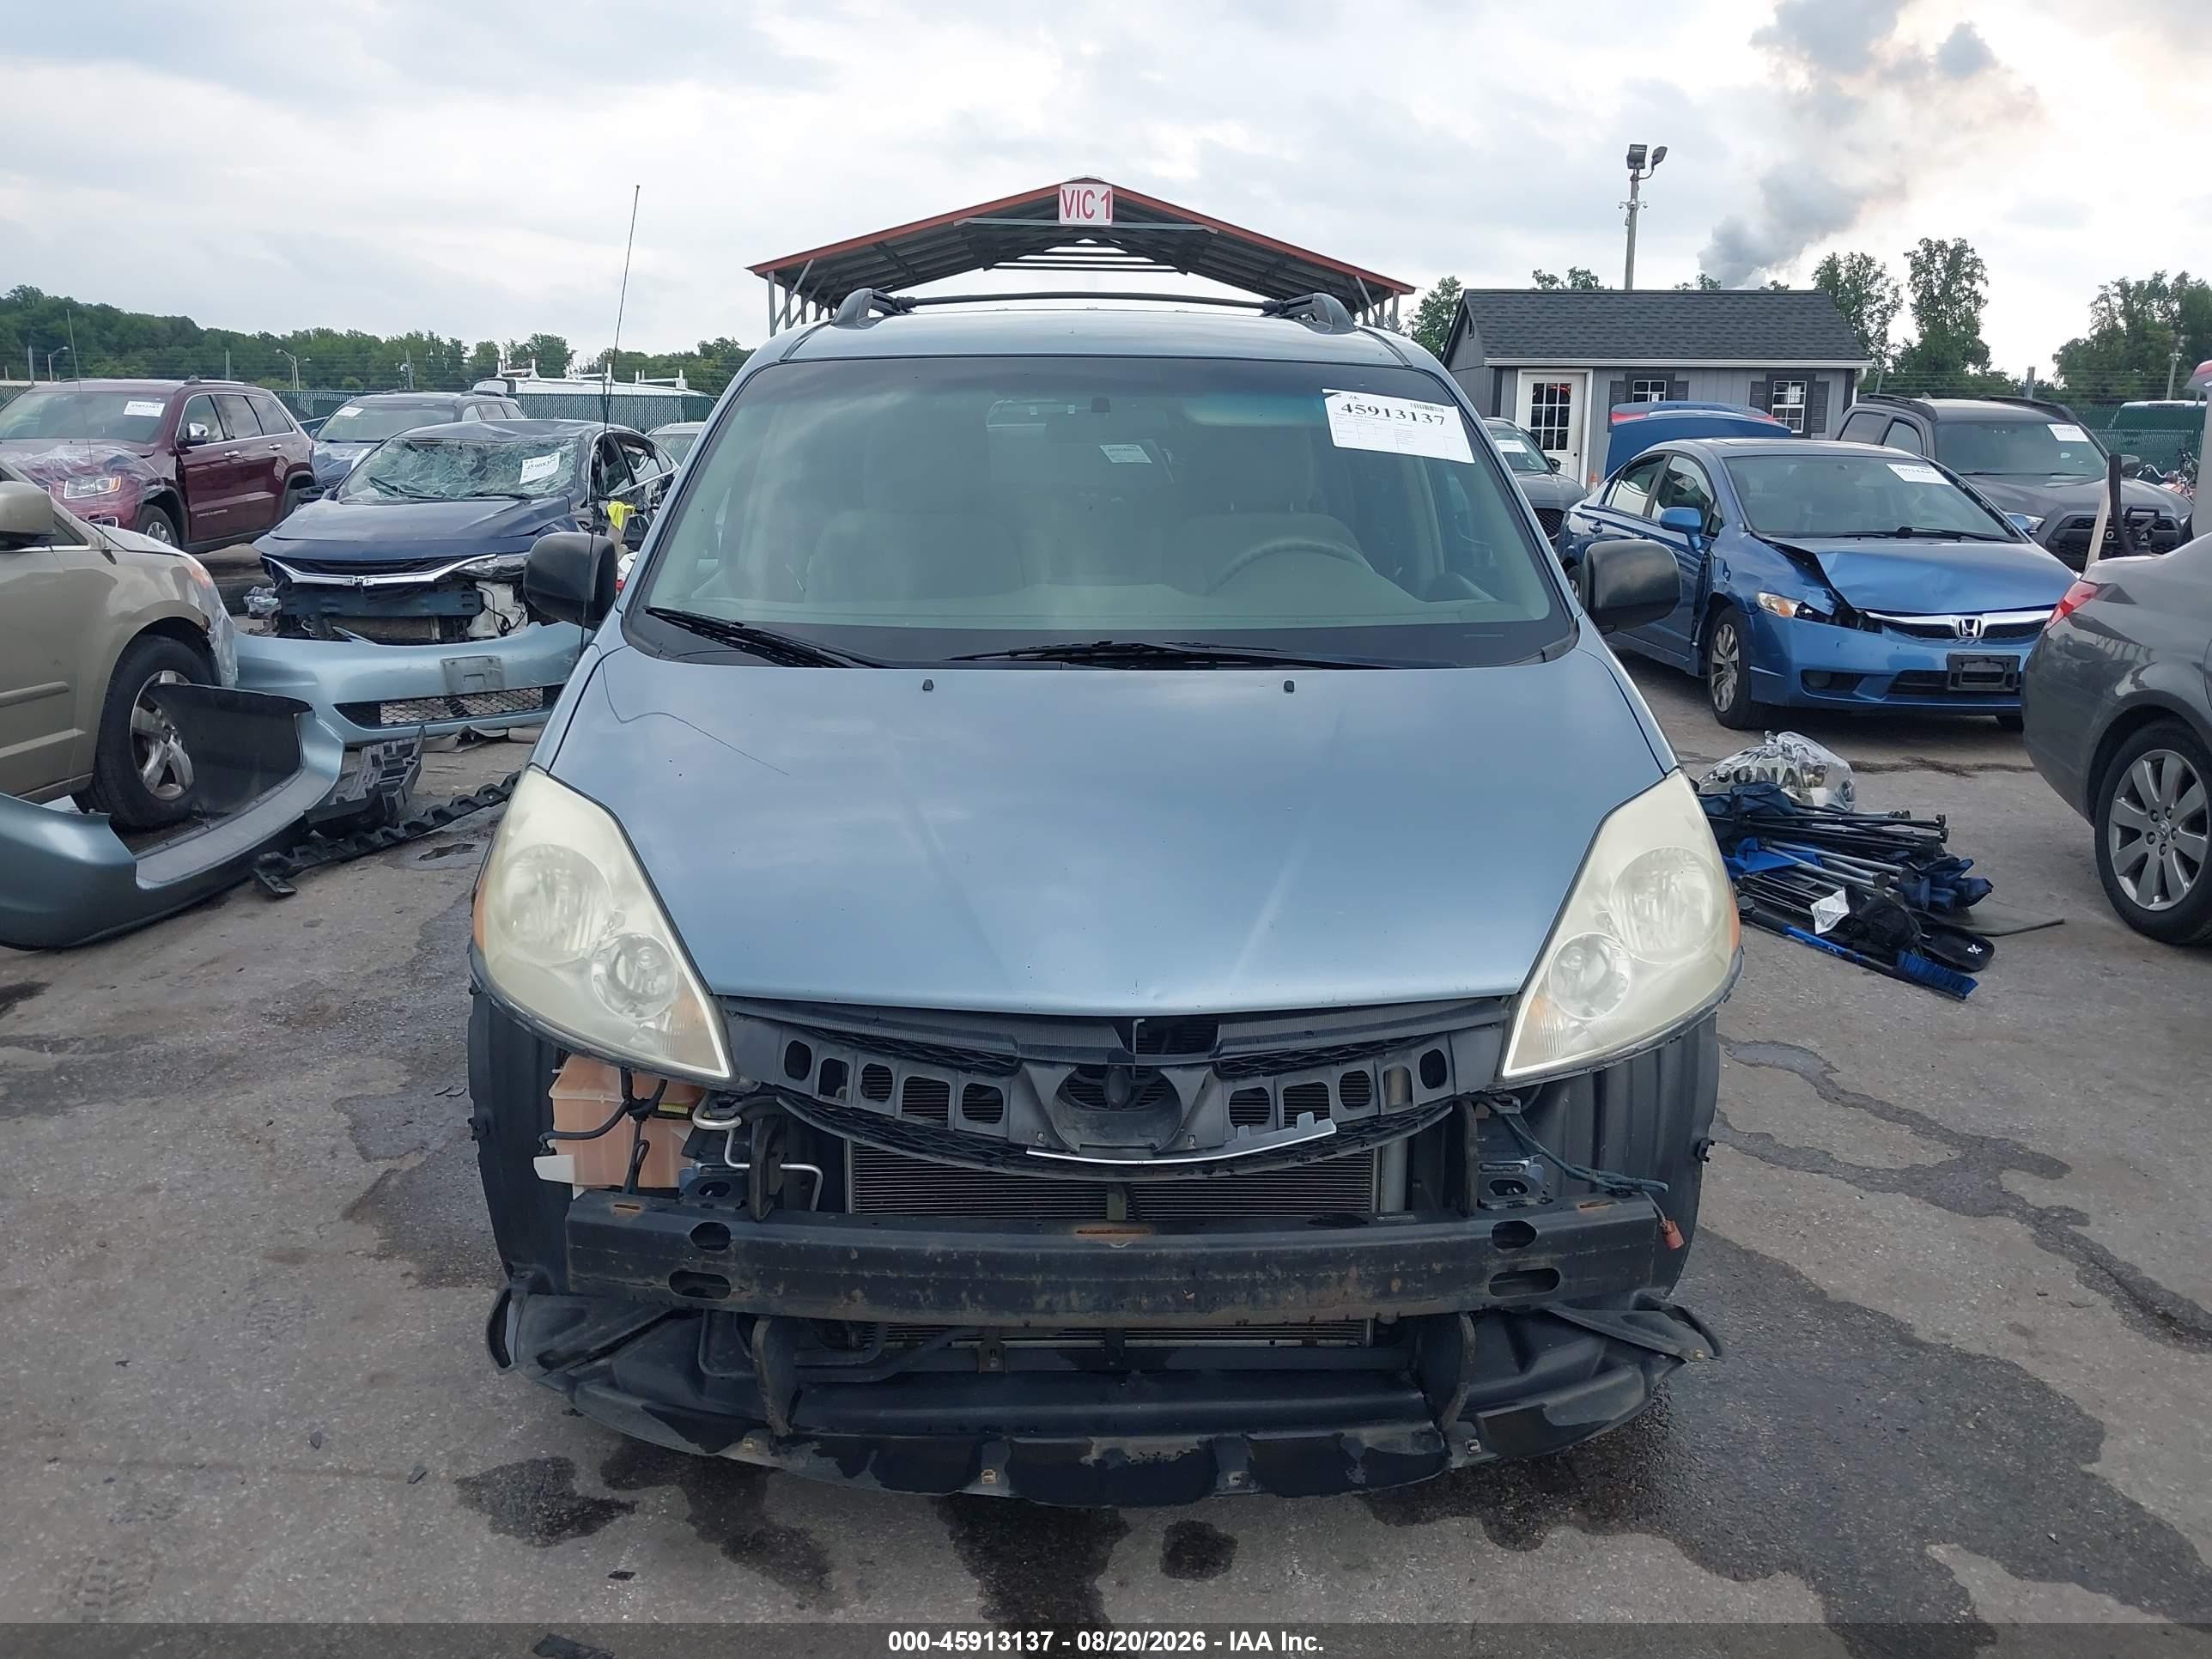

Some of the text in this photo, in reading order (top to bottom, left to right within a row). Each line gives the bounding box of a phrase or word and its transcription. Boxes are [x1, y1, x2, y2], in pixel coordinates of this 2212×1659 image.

[1061, 190, 1111, 220] VIC 1
[1340, 403, 1446, 426] 45913137
